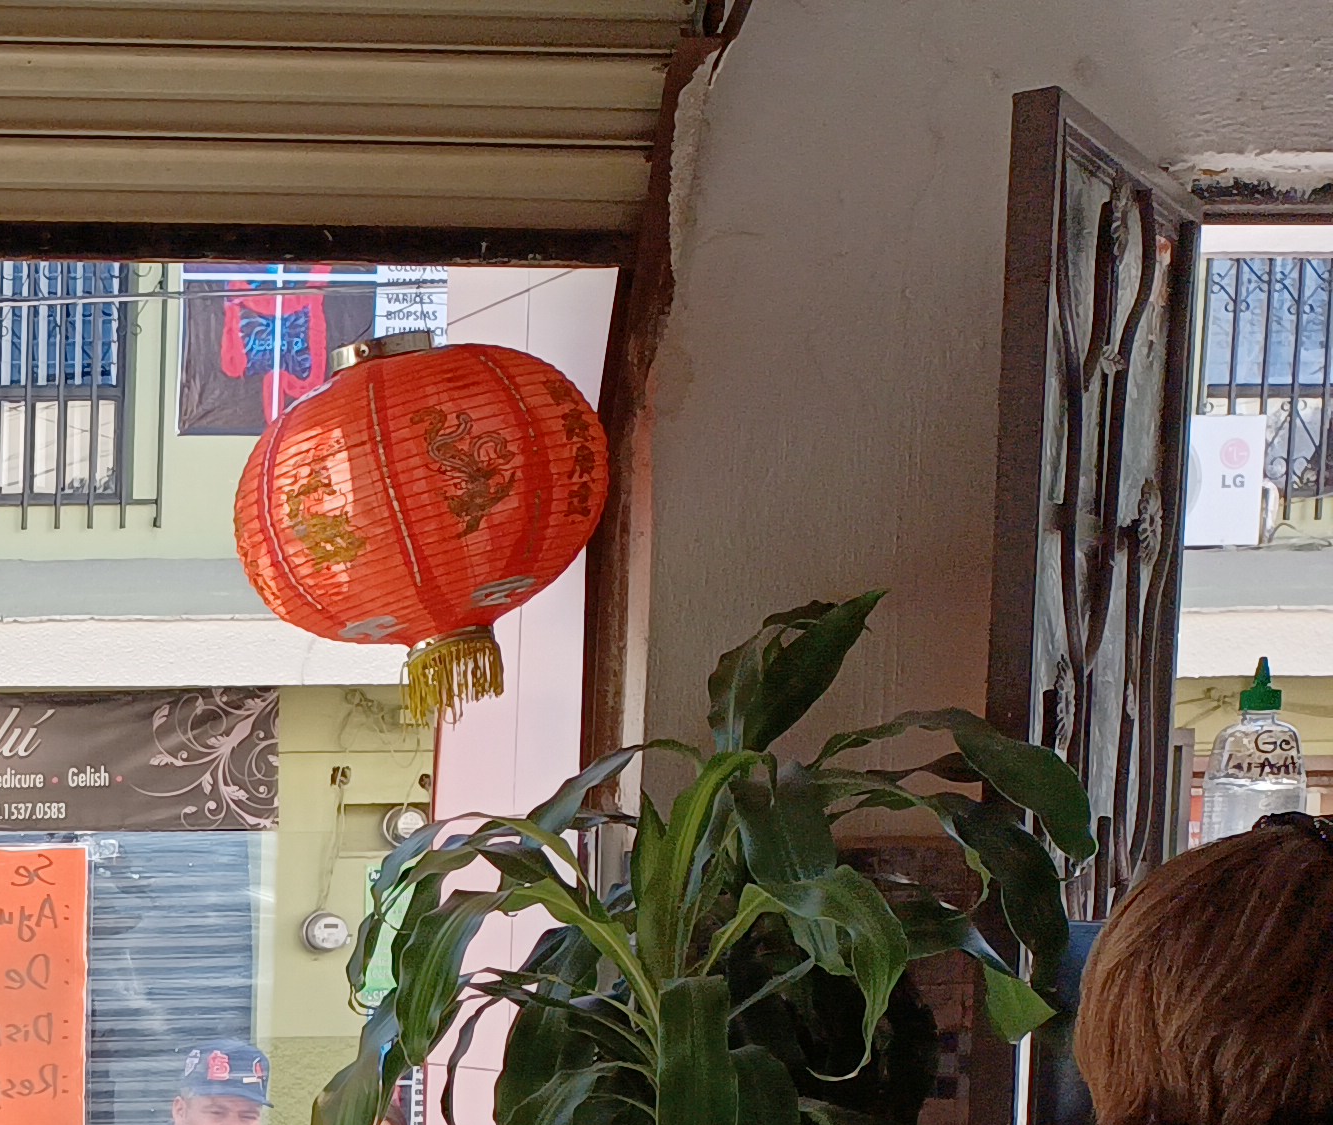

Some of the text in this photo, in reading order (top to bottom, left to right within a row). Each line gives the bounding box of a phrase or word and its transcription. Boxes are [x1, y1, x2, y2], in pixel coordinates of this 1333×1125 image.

[386, 310, 438, 321] BIOPSIAS
[1221, 473, 1246, 489] LG
[67, 764, 110, 788] Gelish
